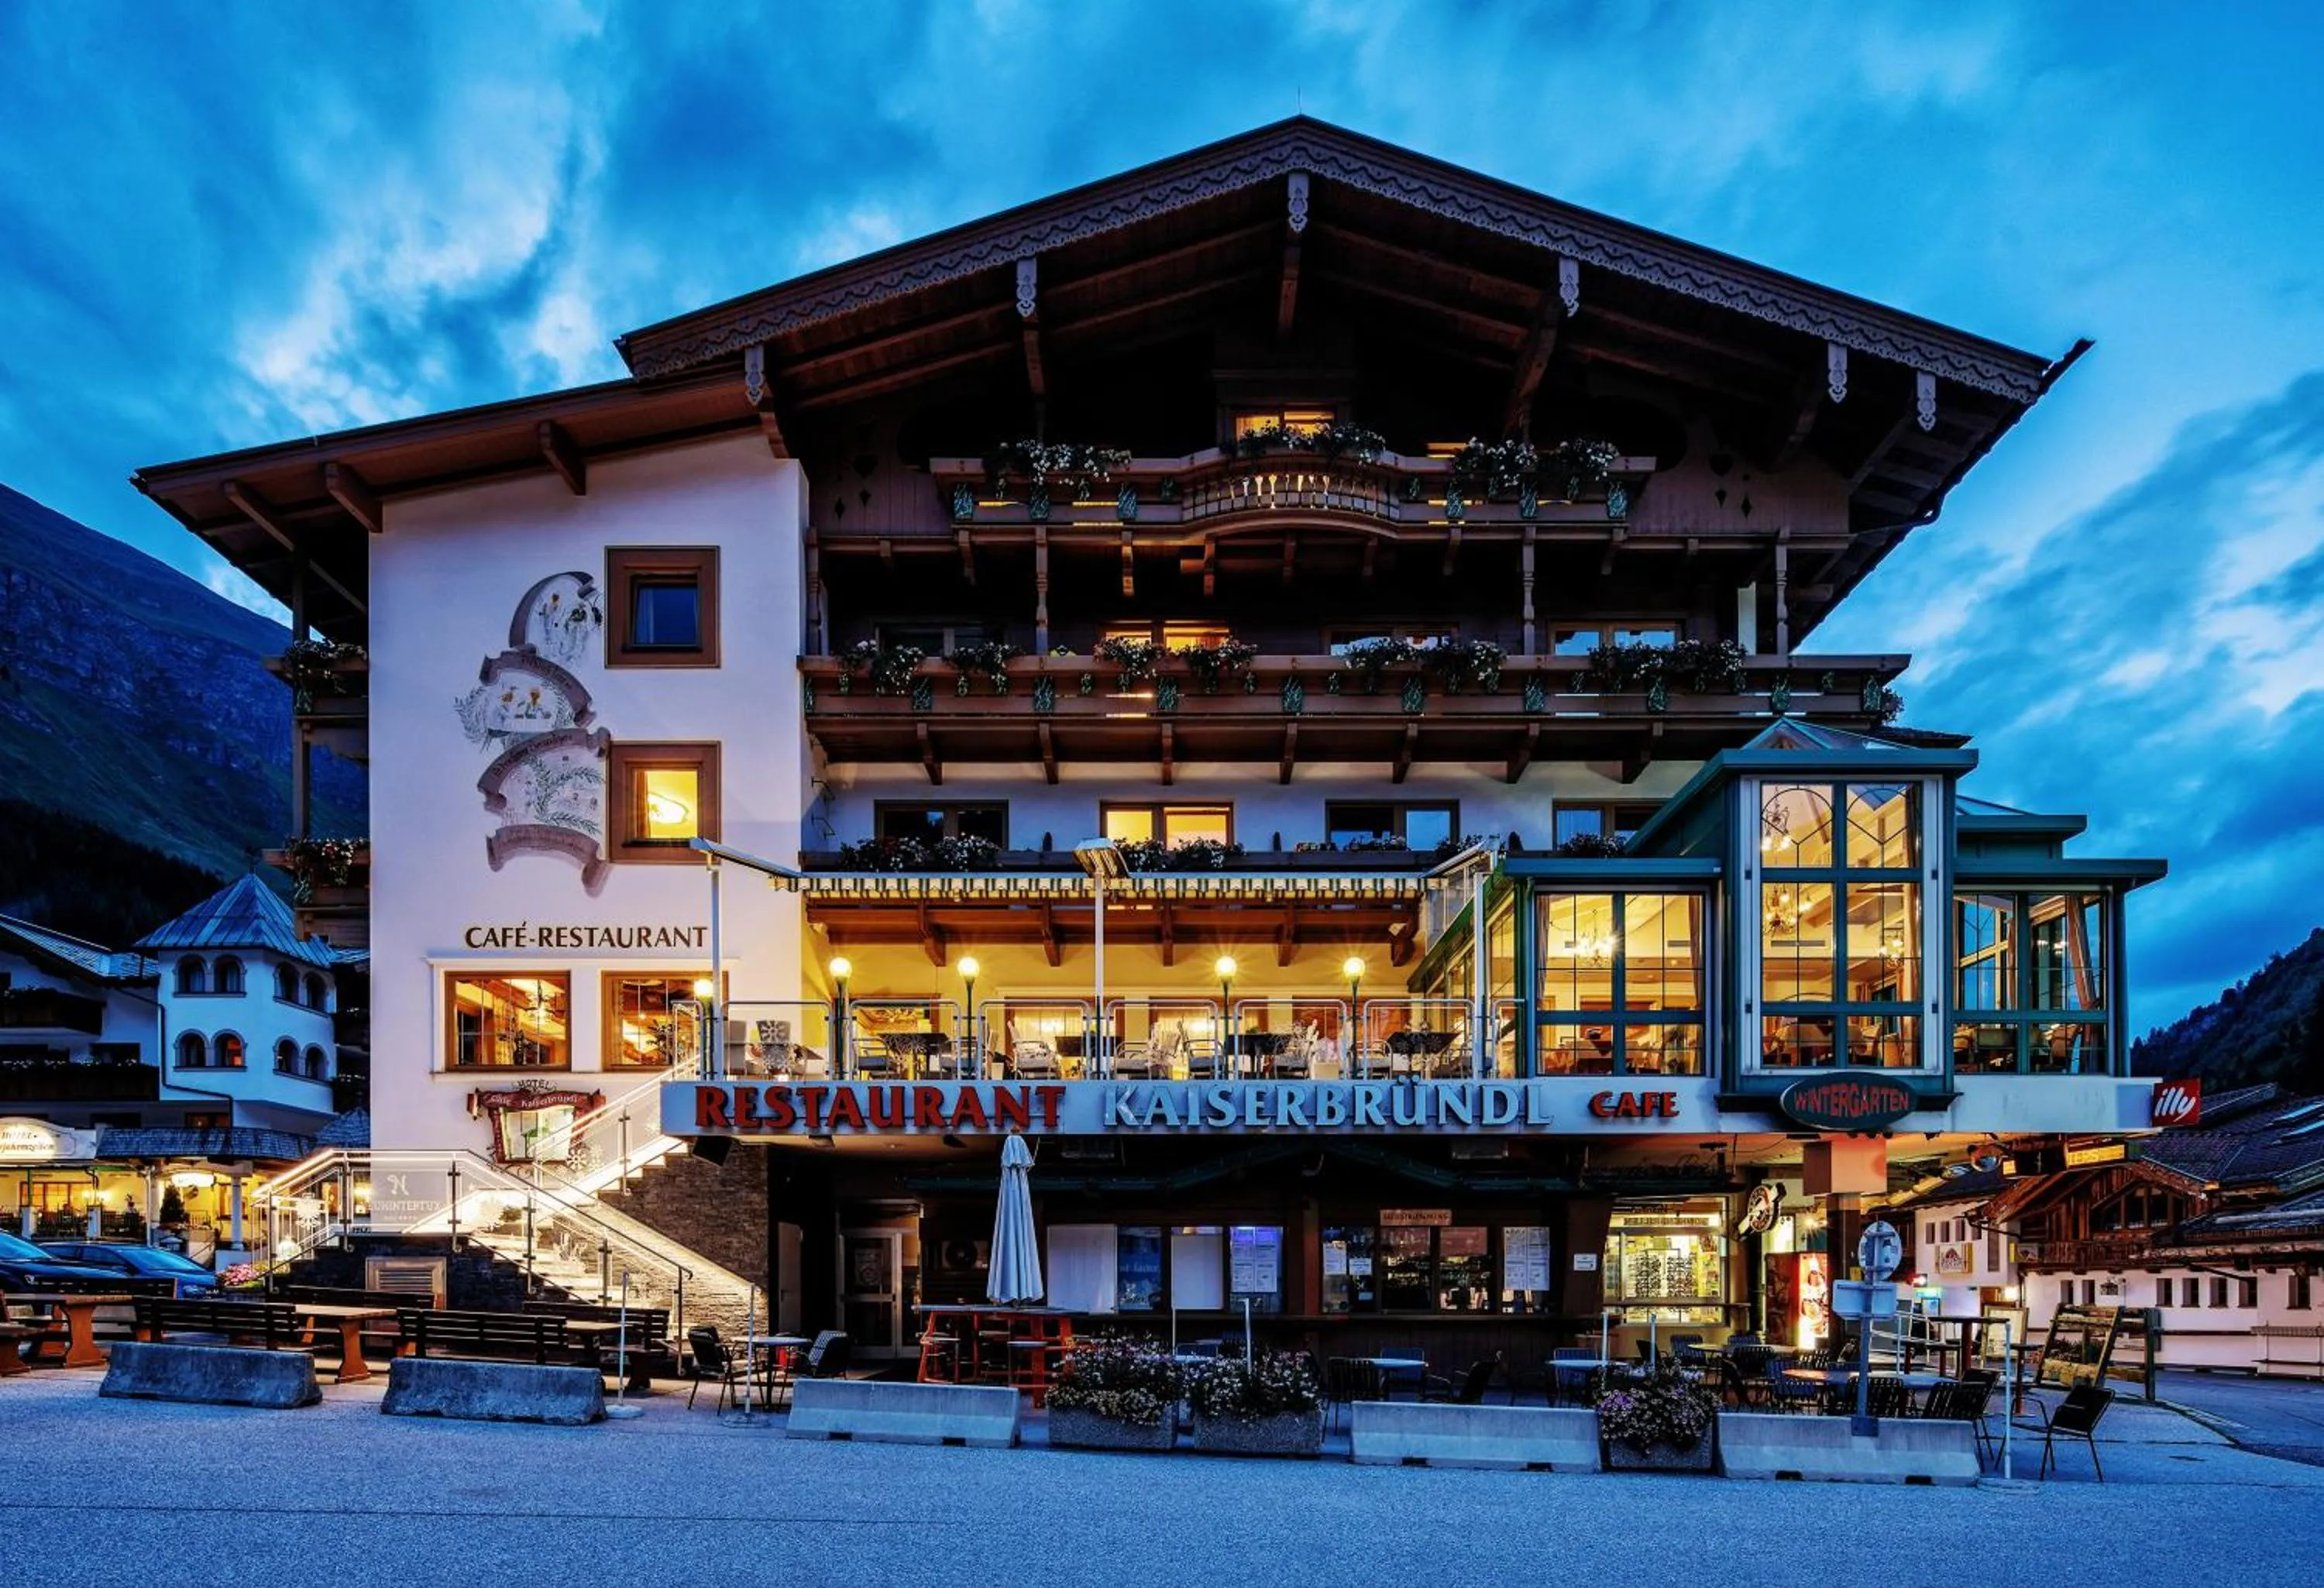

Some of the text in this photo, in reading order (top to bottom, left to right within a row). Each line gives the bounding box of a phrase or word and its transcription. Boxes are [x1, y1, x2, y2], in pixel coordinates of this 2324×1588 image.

[464, 921, 708, 949] CAFÉ-RESTAURANT
[517, 1079, 552, 1091] HOTEL
[694, 1074, 1680, 1130] RESTAURANT KAISERBRÜNDL CAFE
[1793, 1082, 1910, 1119] WINTERGARTEN
[2154, 1086, 2197, 1123] illy
